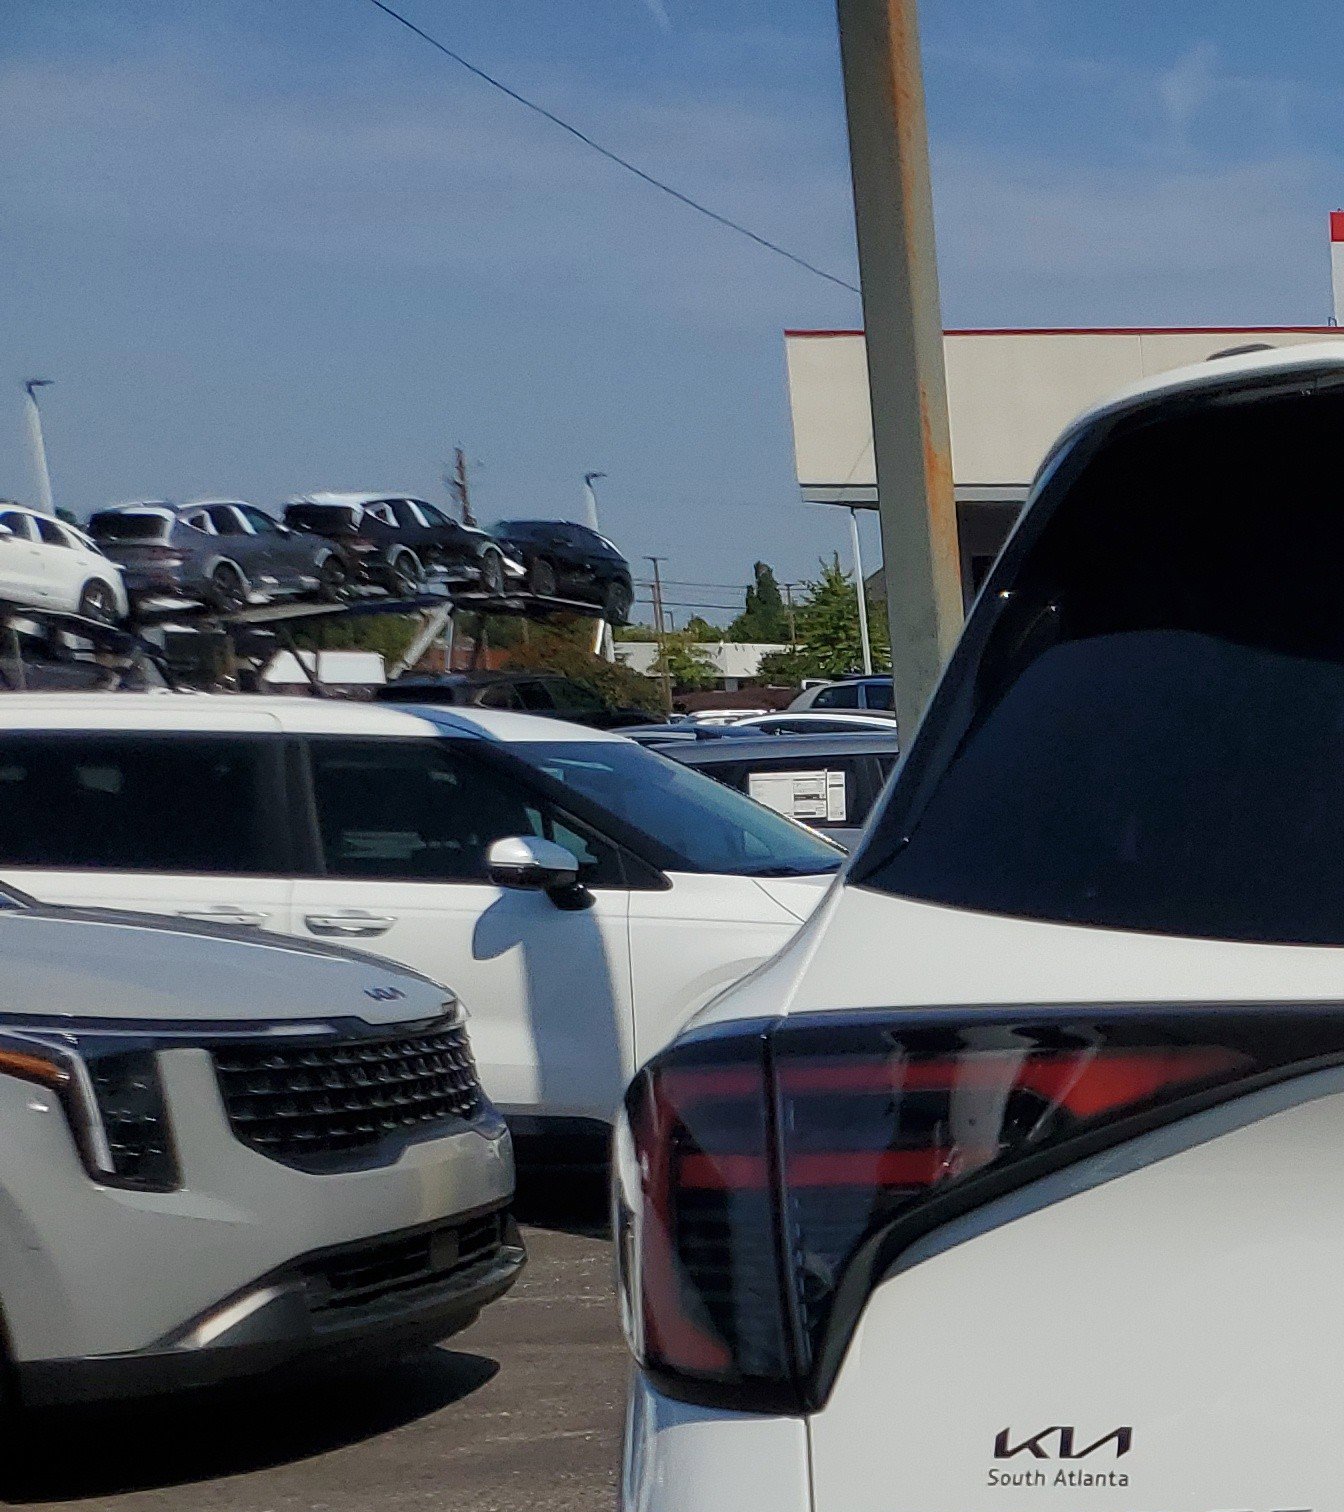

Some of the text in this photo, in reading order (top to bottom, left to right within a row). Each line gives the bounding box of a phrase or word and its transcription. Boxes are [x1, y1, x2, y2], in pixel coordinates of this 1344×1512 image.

[994, 1426, 1132, 1459] KIA
[987, 1469, 1129, 1487] South Atlanta
